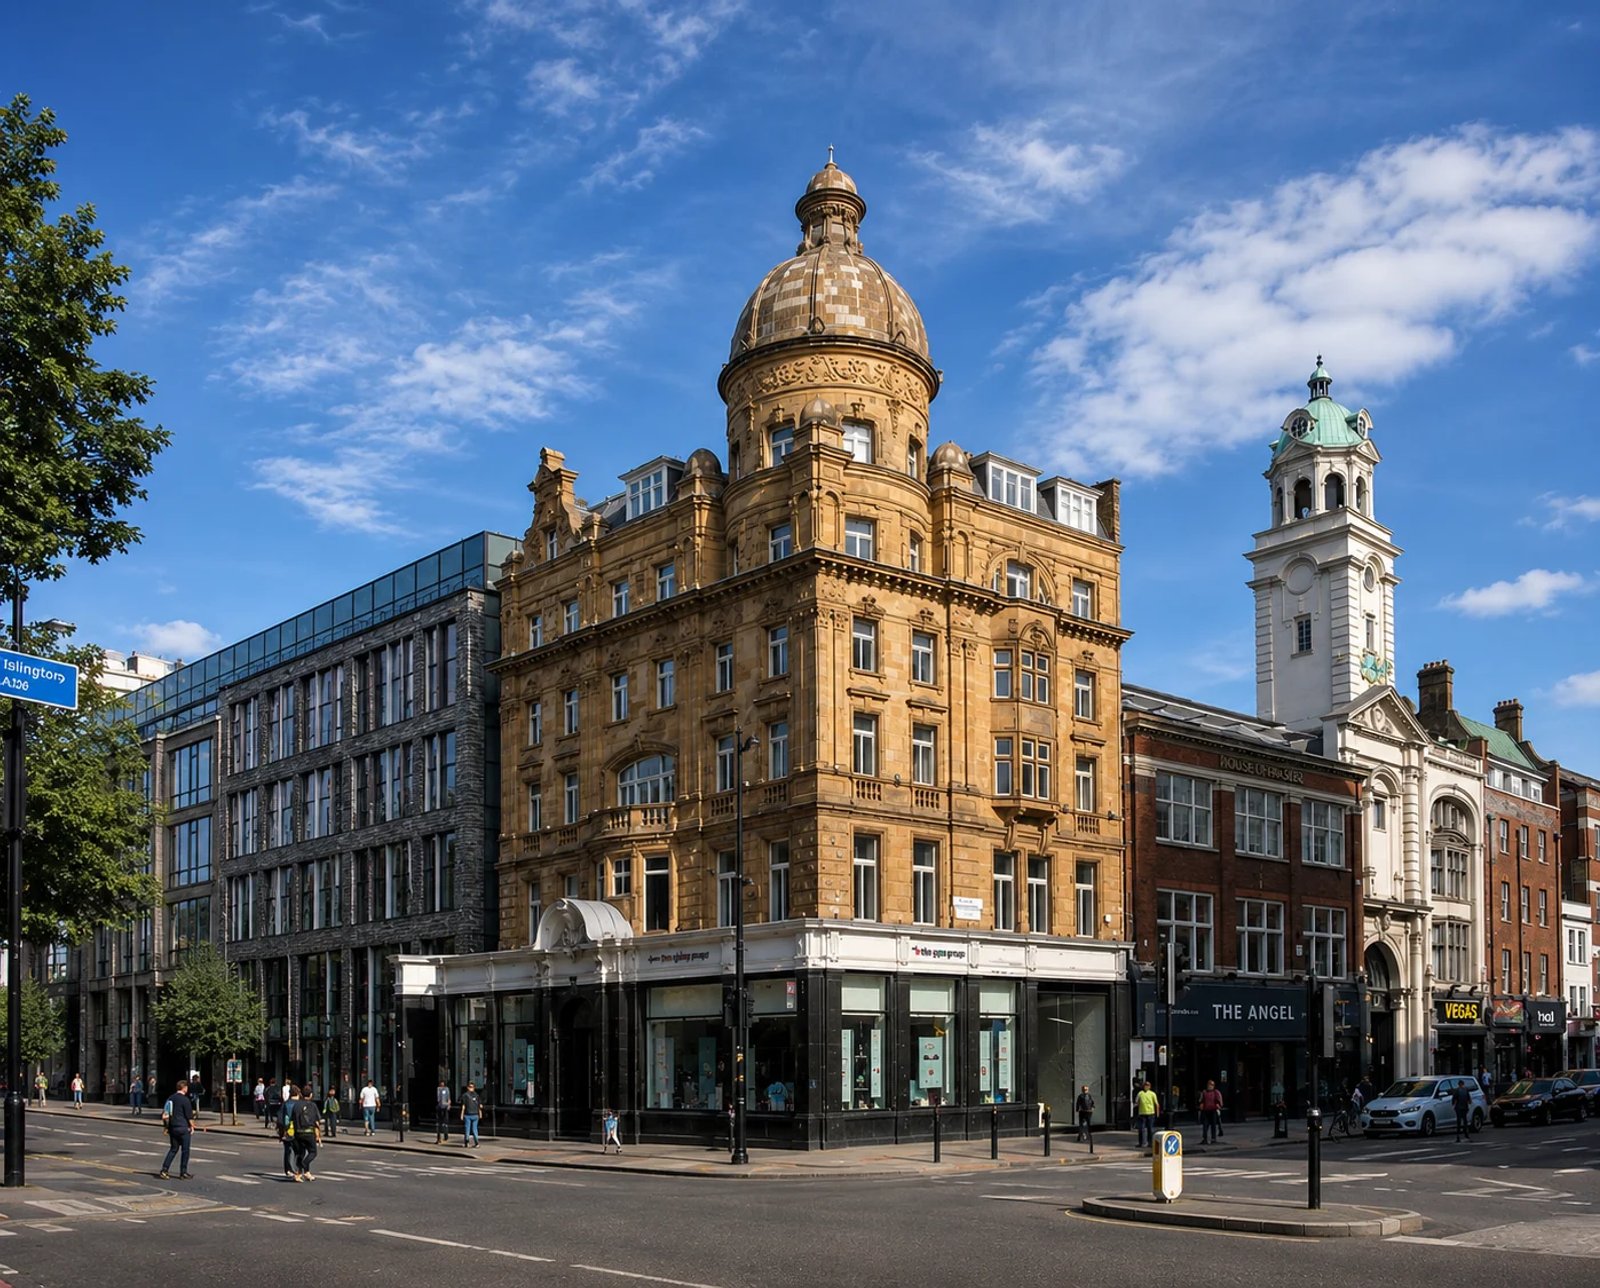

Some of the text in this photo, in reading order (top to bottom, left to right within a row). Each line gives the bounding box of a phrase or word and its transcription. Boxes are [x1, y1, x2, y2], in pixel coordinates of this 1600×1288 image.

[1212, 1004, 1242, 1020] THE
[1247, 1005, 1295, 1020] ANGEL
[1445, 1002, 1478, 1019] VEGAS
